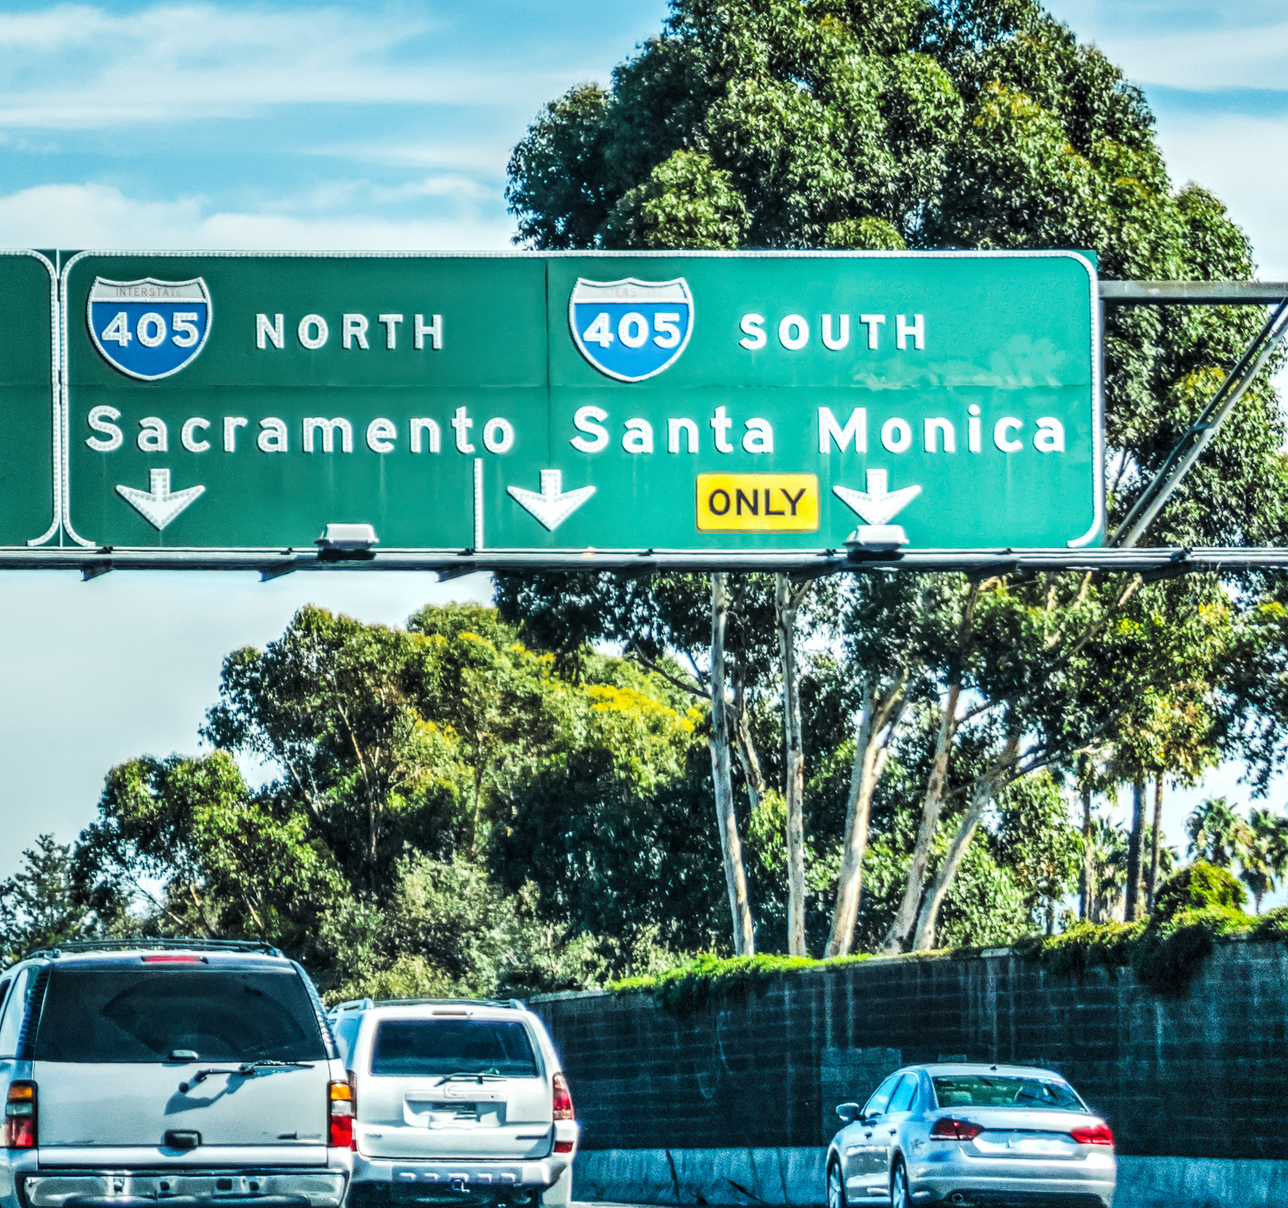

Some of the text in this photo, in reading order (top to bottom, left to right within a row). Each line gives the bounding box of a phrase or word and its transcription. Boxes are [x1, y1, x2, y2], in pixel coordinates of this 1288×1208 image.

[101, 312, 444, 350] 405 NORTH
[582, 312, 926, 351] 405 SOUTH
[85, 406, 516, 454] Sacramento
[570, 404, 1066, 454] Santa Monica
[708, 489, 807, 516] ONLY
